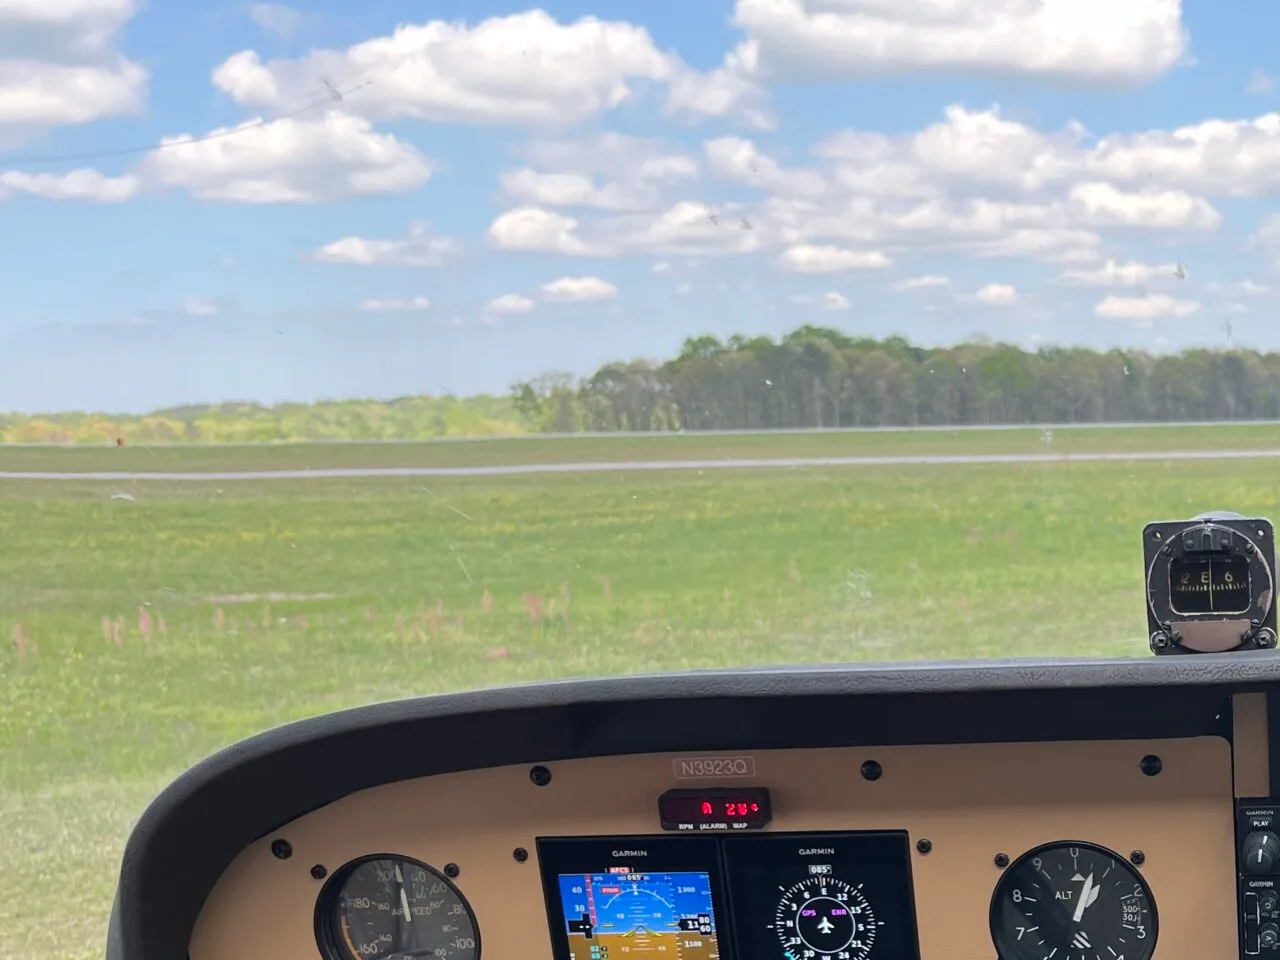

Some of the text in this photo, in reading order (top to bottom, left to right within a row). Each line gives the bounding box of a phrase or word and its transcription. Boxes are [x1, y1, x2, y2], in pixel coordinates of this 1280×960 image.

[1201, 571, 1233, 583] E 6
[682, 760, 747, 776] N3923Q
[1055, 891, 1072, 899] ALT
